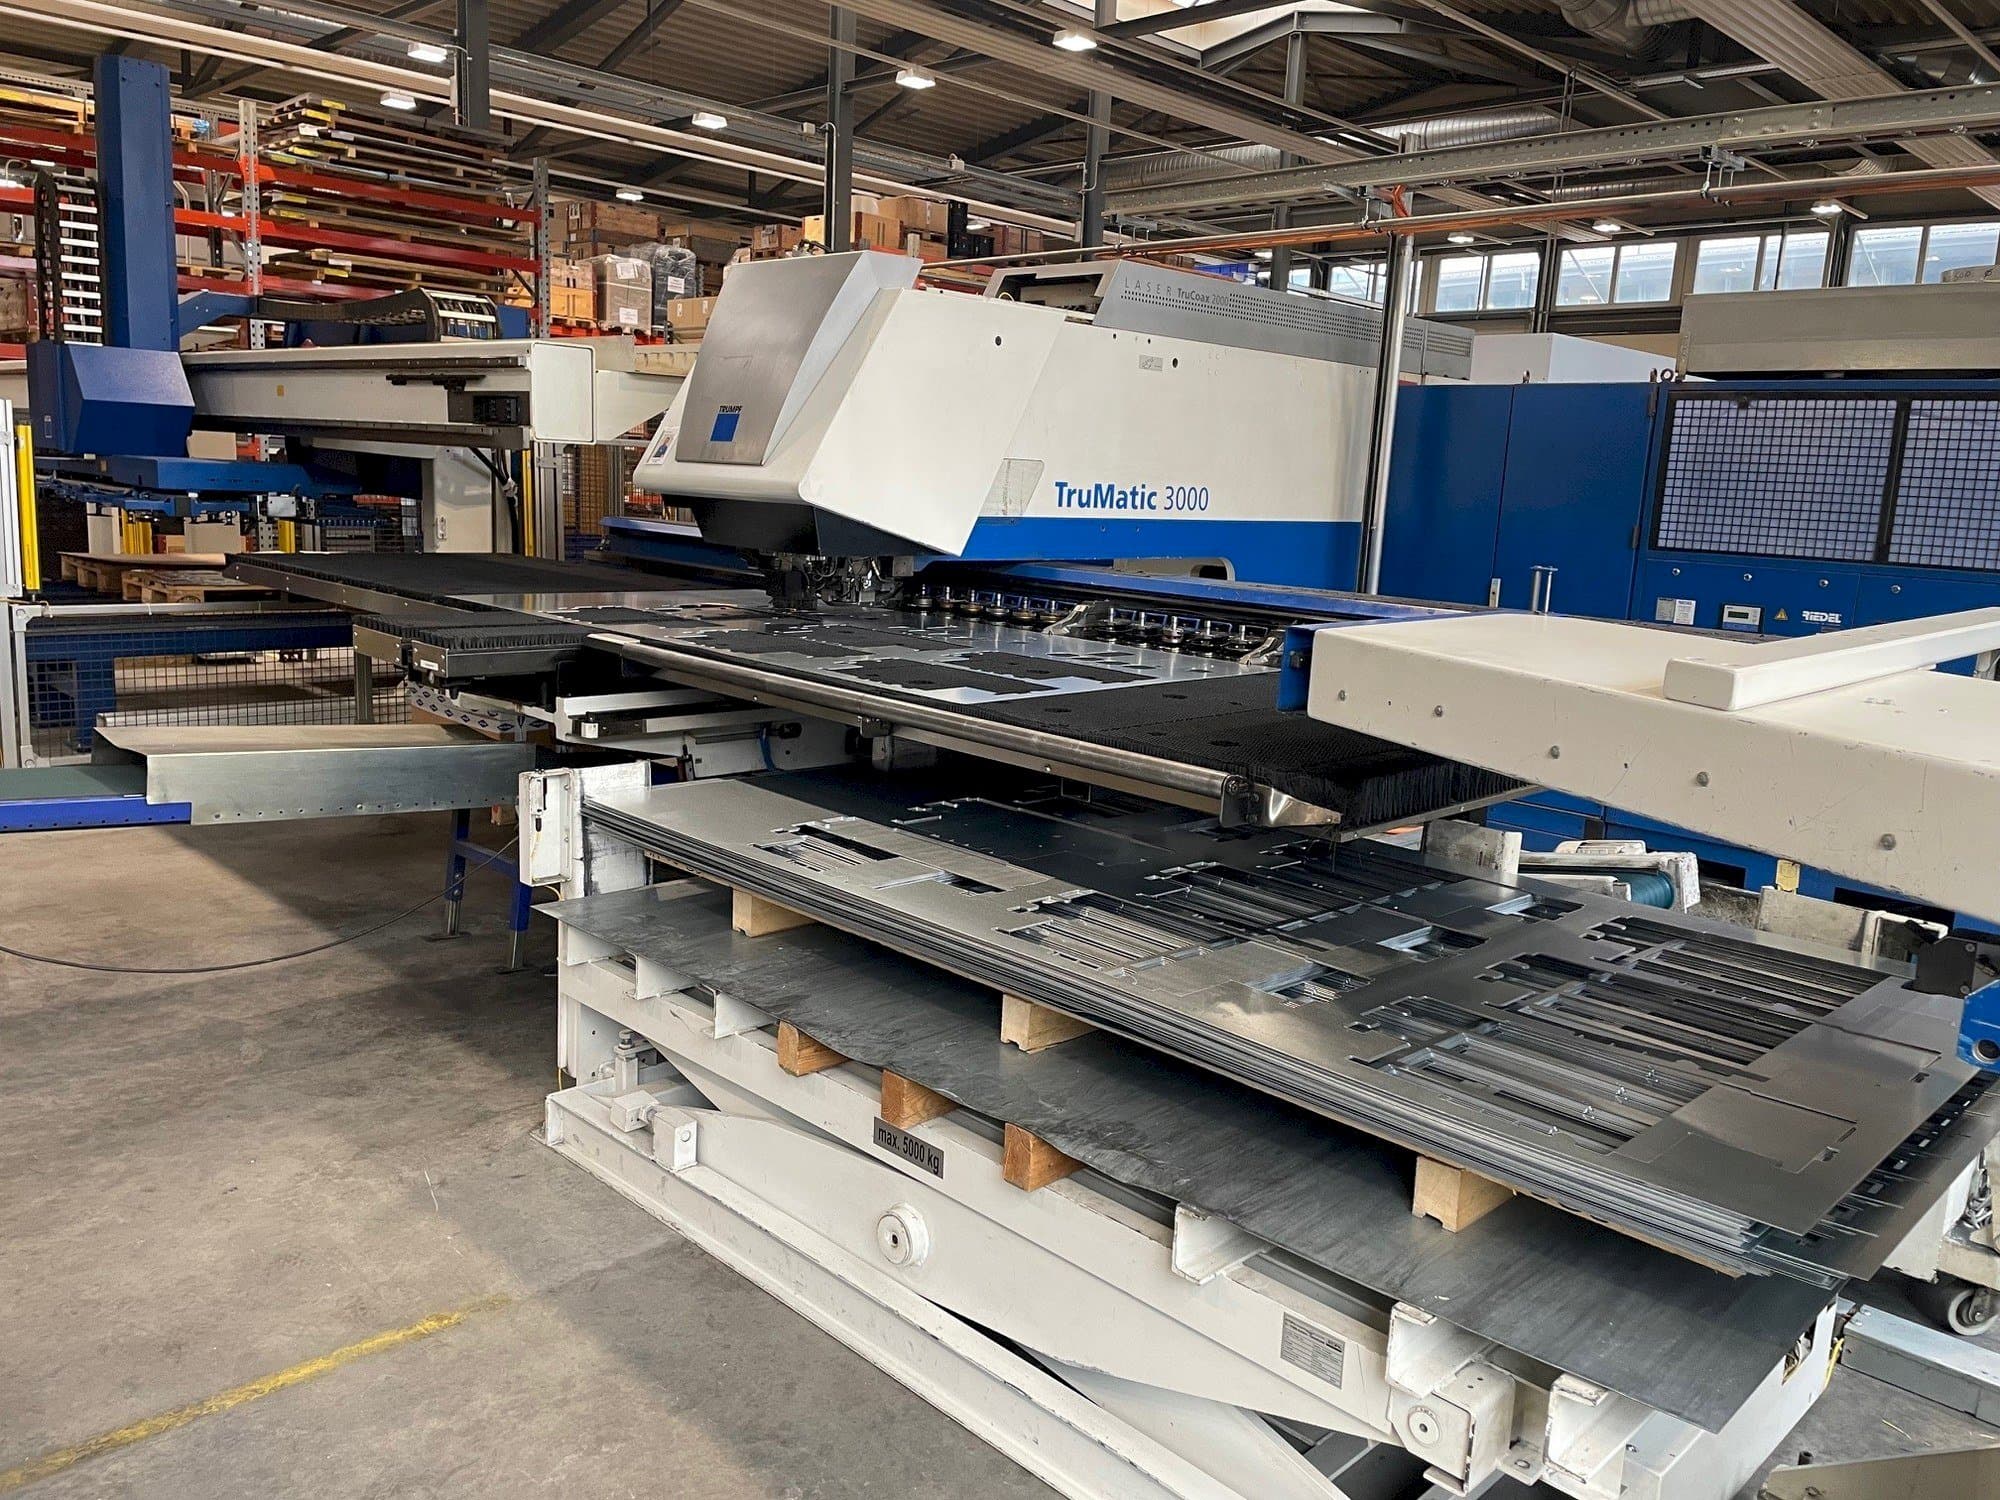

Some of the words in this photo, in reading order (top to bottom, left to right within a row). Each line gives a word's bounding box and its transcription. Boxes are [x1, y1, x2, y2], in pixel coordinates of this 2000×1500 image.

[1125, 277, 1172, 296] LASER
[1178, 288, 1209, 302] TruCoax
[1212, 294, 1229, 306] 2000
[719, 405, 742, 413] TRUMPF
[1055, 481, 1157, 510] TruMatic
[1163, 487, 1209, 511] 3000
[1802, 610, 1841, 623] RIEDEL
[878, 1127, 899, 1150] max.
[902, 1136, 925, 1162] 5000
[927, 1148, 939, 1174] kg
